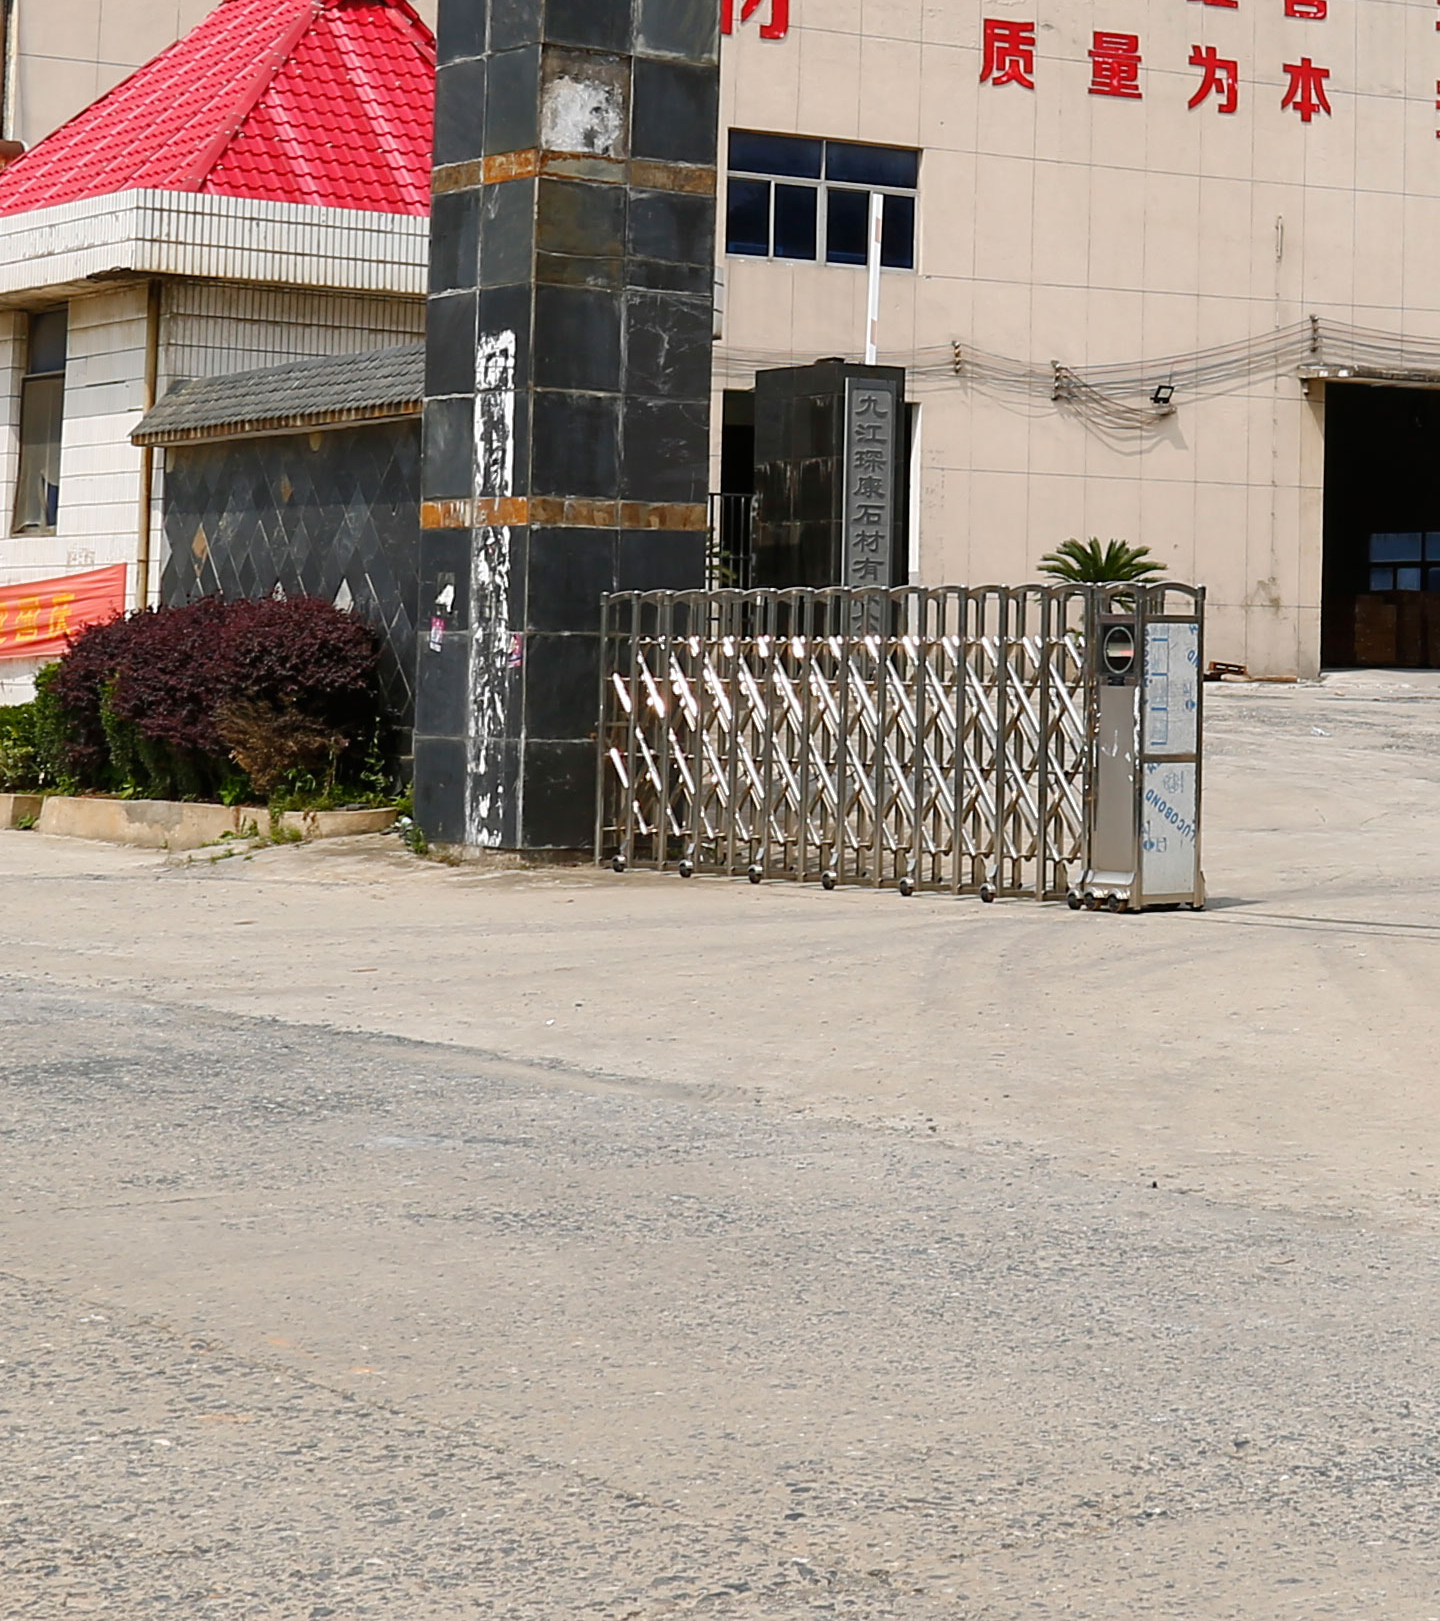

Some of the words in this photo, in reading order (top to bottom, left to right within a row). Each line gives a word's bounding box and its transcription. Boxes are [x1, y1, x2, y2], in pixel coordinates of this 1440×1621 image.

[978, 17, 1332, 123] 质量为本
[852, 394, 889, 680] 九江琛康石材有公
